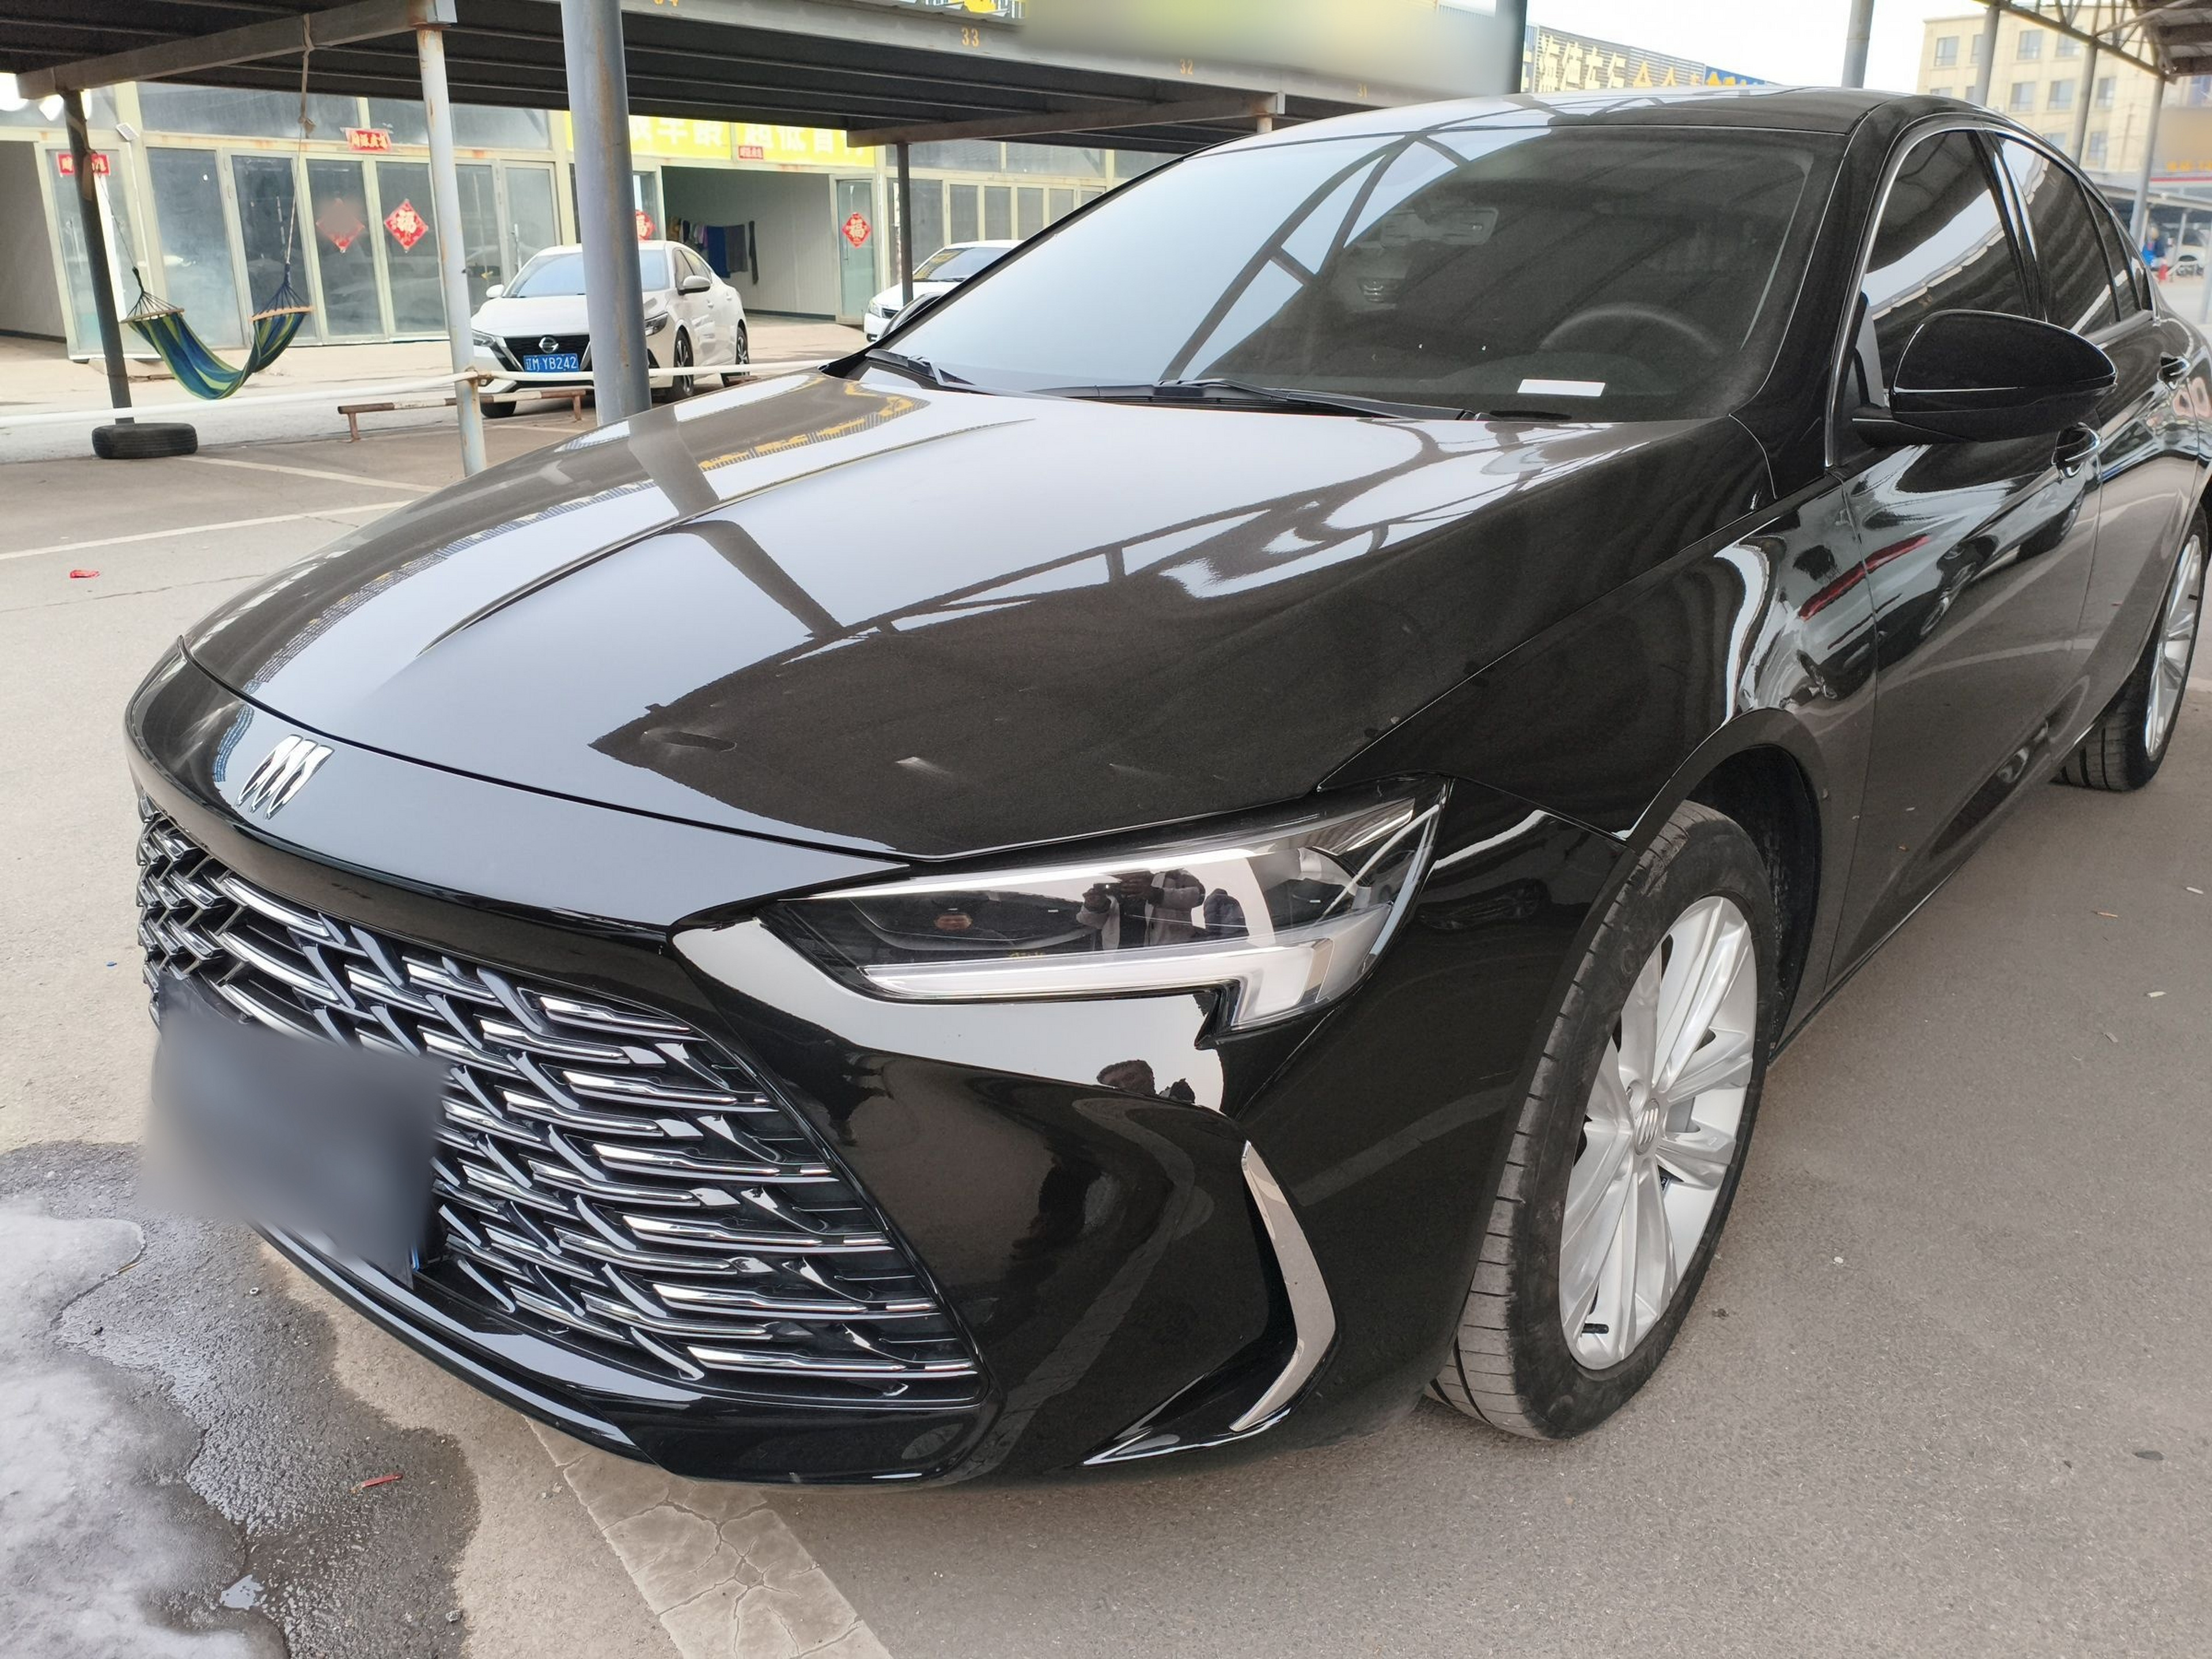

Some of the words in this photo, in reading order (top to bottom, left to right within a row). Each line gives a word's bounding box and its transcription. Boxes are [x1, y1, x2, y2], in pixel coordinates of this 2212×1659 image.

[961, 27, 979, 47] 33
[1180, 59, 1194, 75] 32
[848, 218, 865, 239] 福
